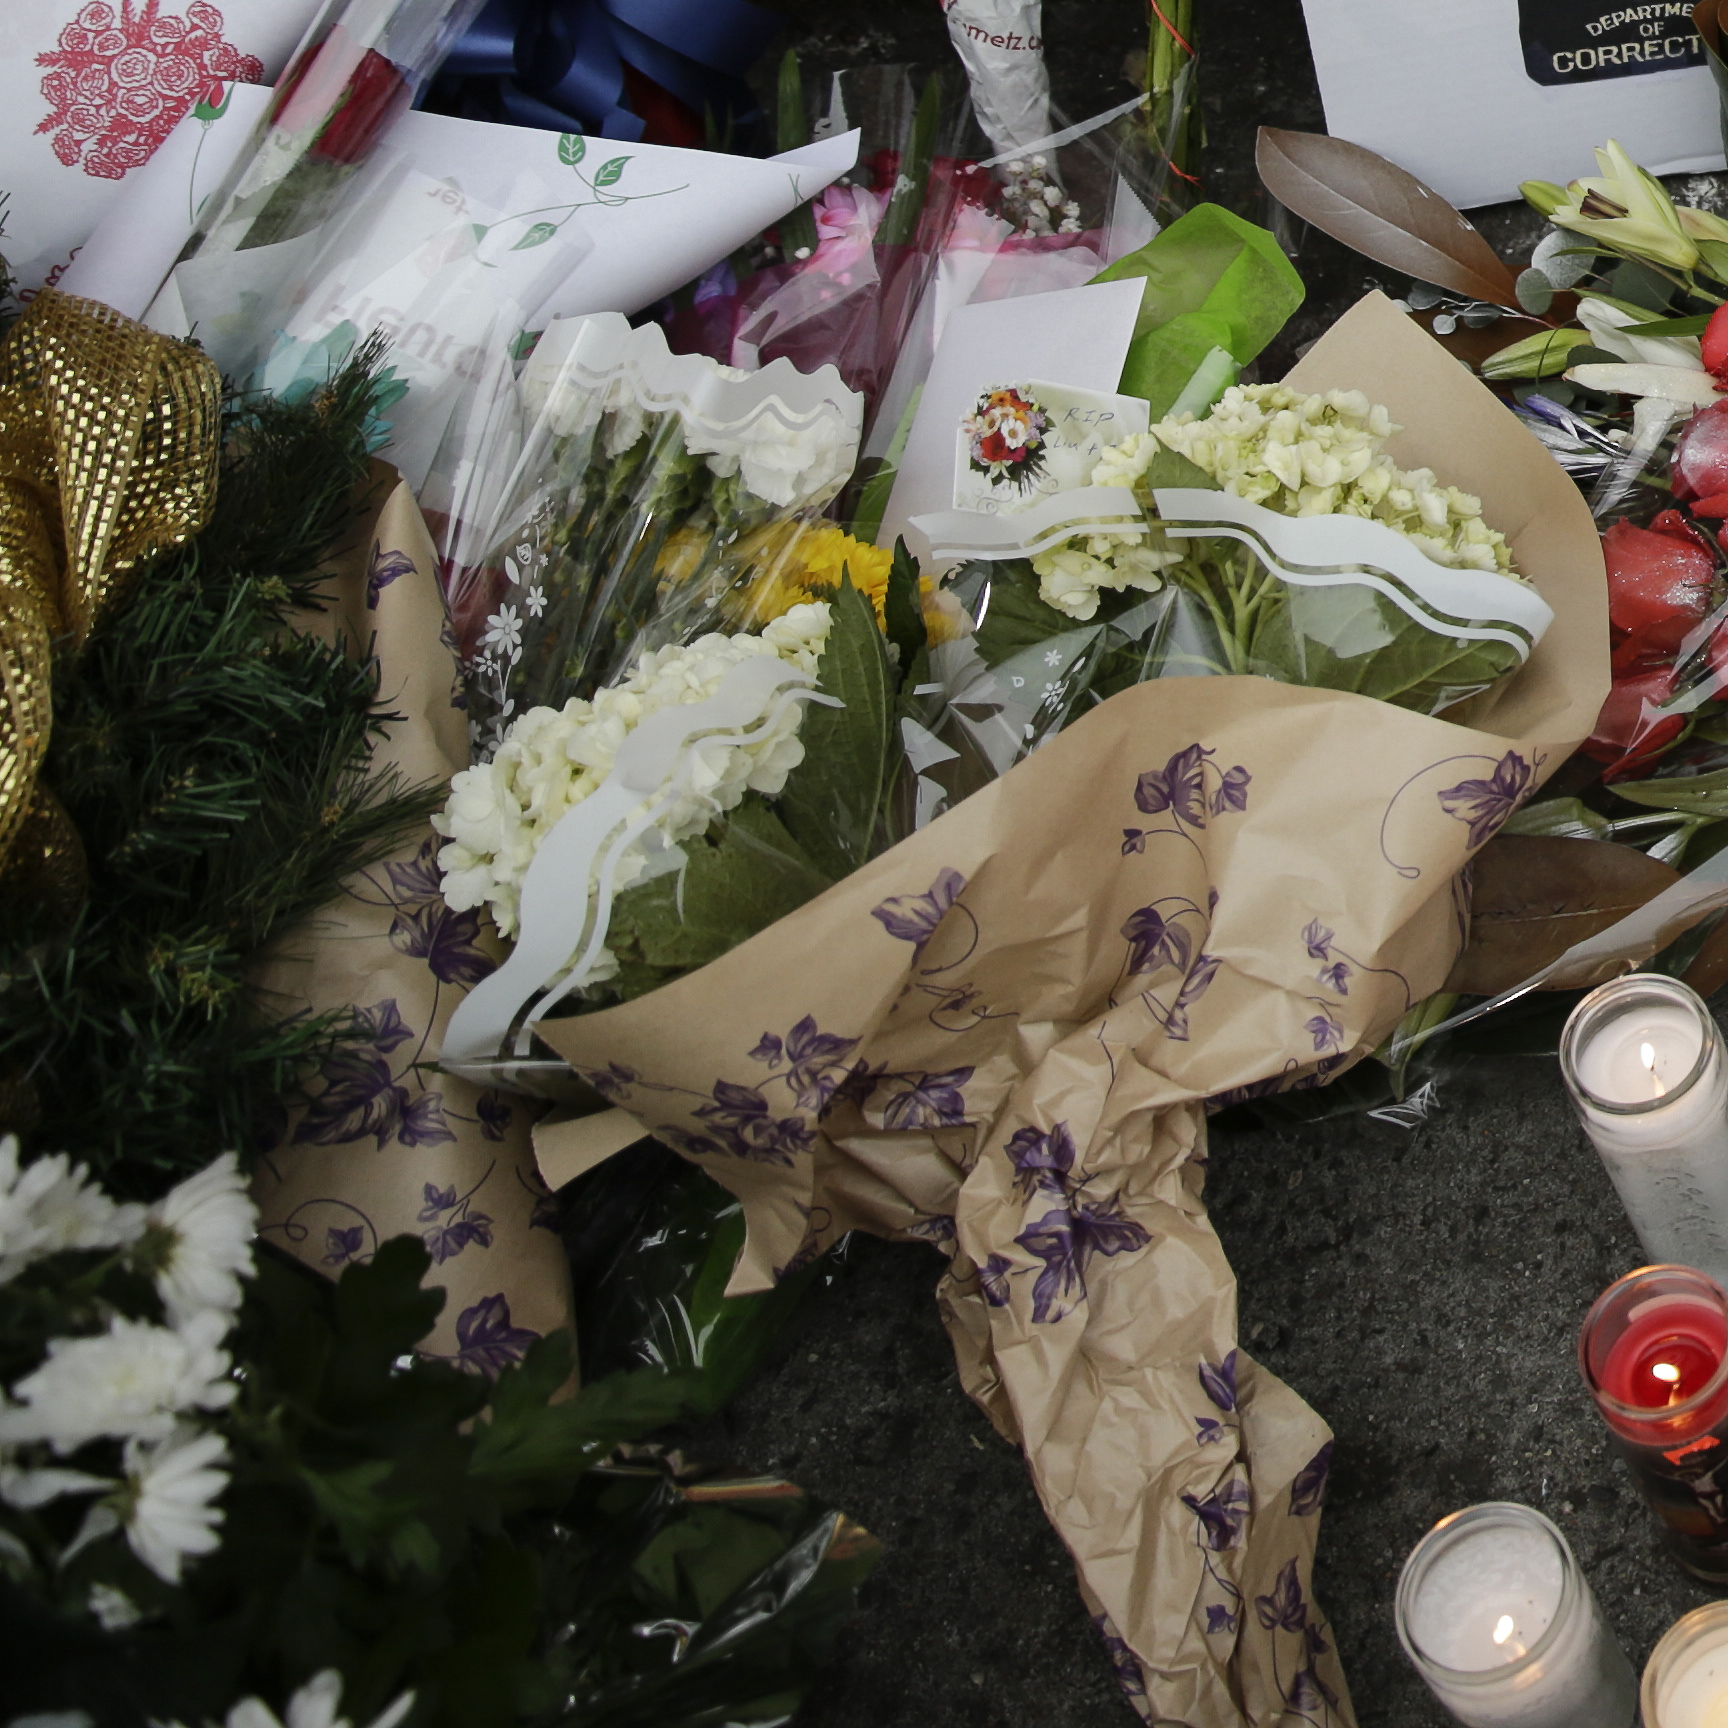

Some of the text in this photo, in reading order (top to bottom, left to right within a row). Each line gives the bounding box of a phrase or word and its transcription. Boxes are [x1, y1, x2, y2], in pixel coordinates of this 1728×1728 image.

[1586, 2, 1696, 37] DEPARTME
[1639, 22, 1664, 38] OF
[1553, 35, 1703, 73] CORRECT
[1063, 407, 1114, 427] RIP
